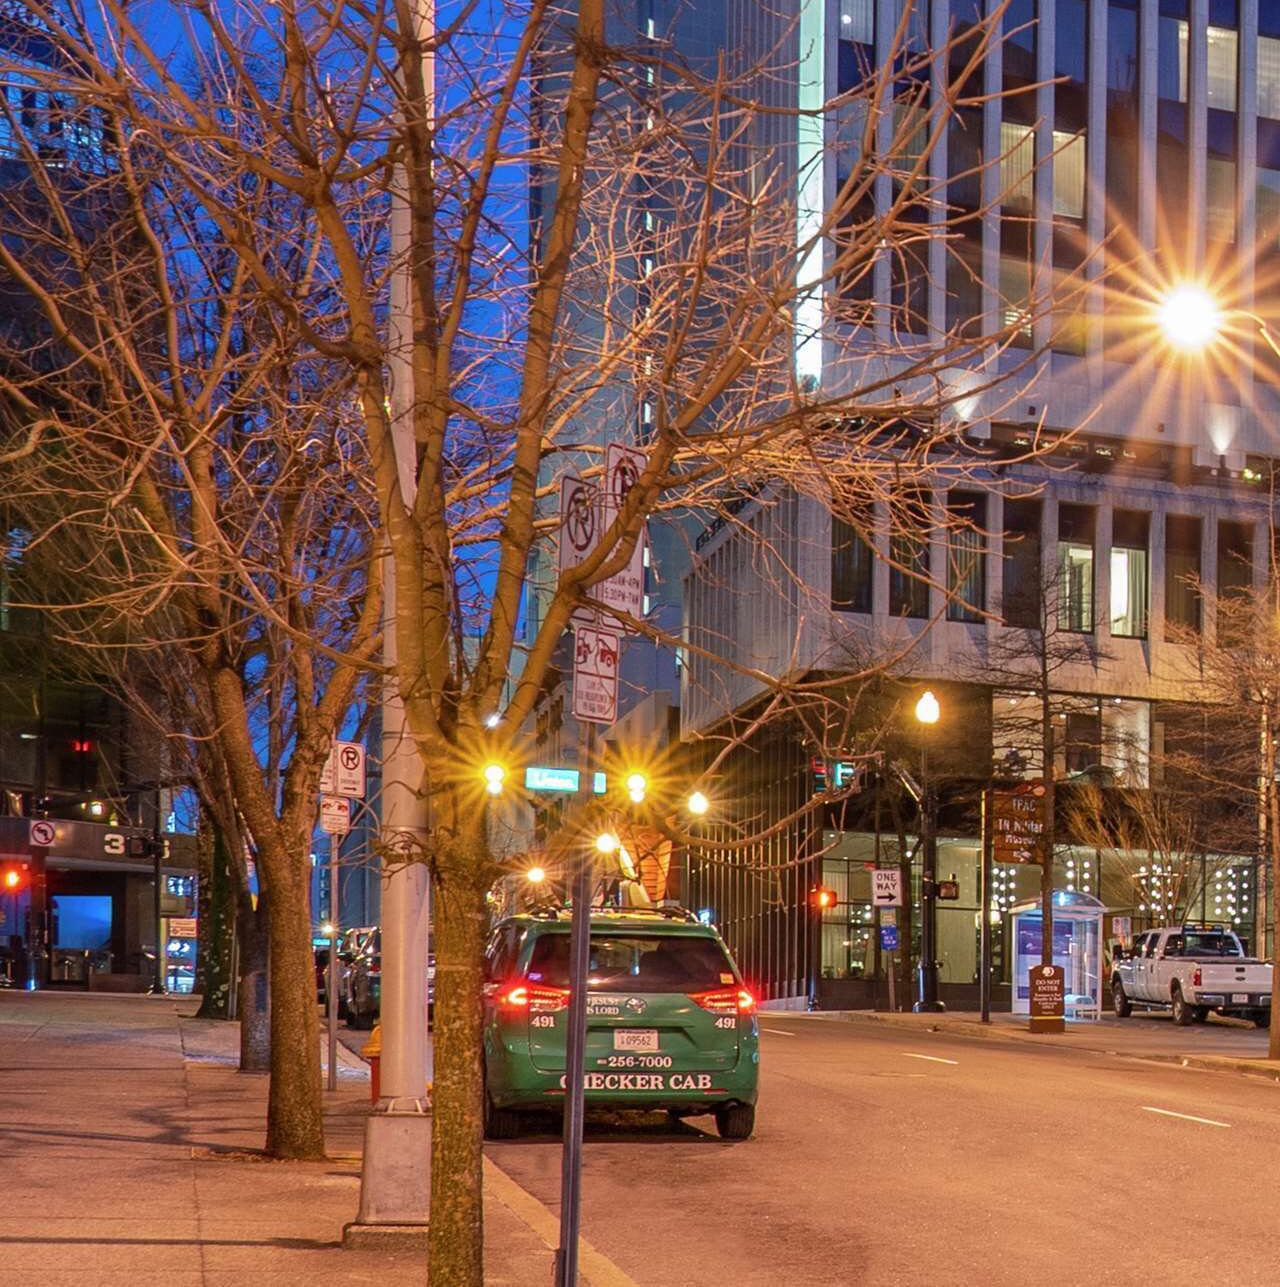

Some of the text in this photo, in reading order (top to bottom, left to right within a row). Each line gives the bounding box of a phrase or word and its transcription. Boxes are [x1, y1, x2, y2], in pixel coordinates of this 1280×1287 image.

[876, 873, 897, 882] ONE
[876, 882, 897, 891] WAY
[531, 1015, 555, 1028] 491
[714, 1016, 737, 1029] 491
[669, 1074, 712, 1090] CAB
